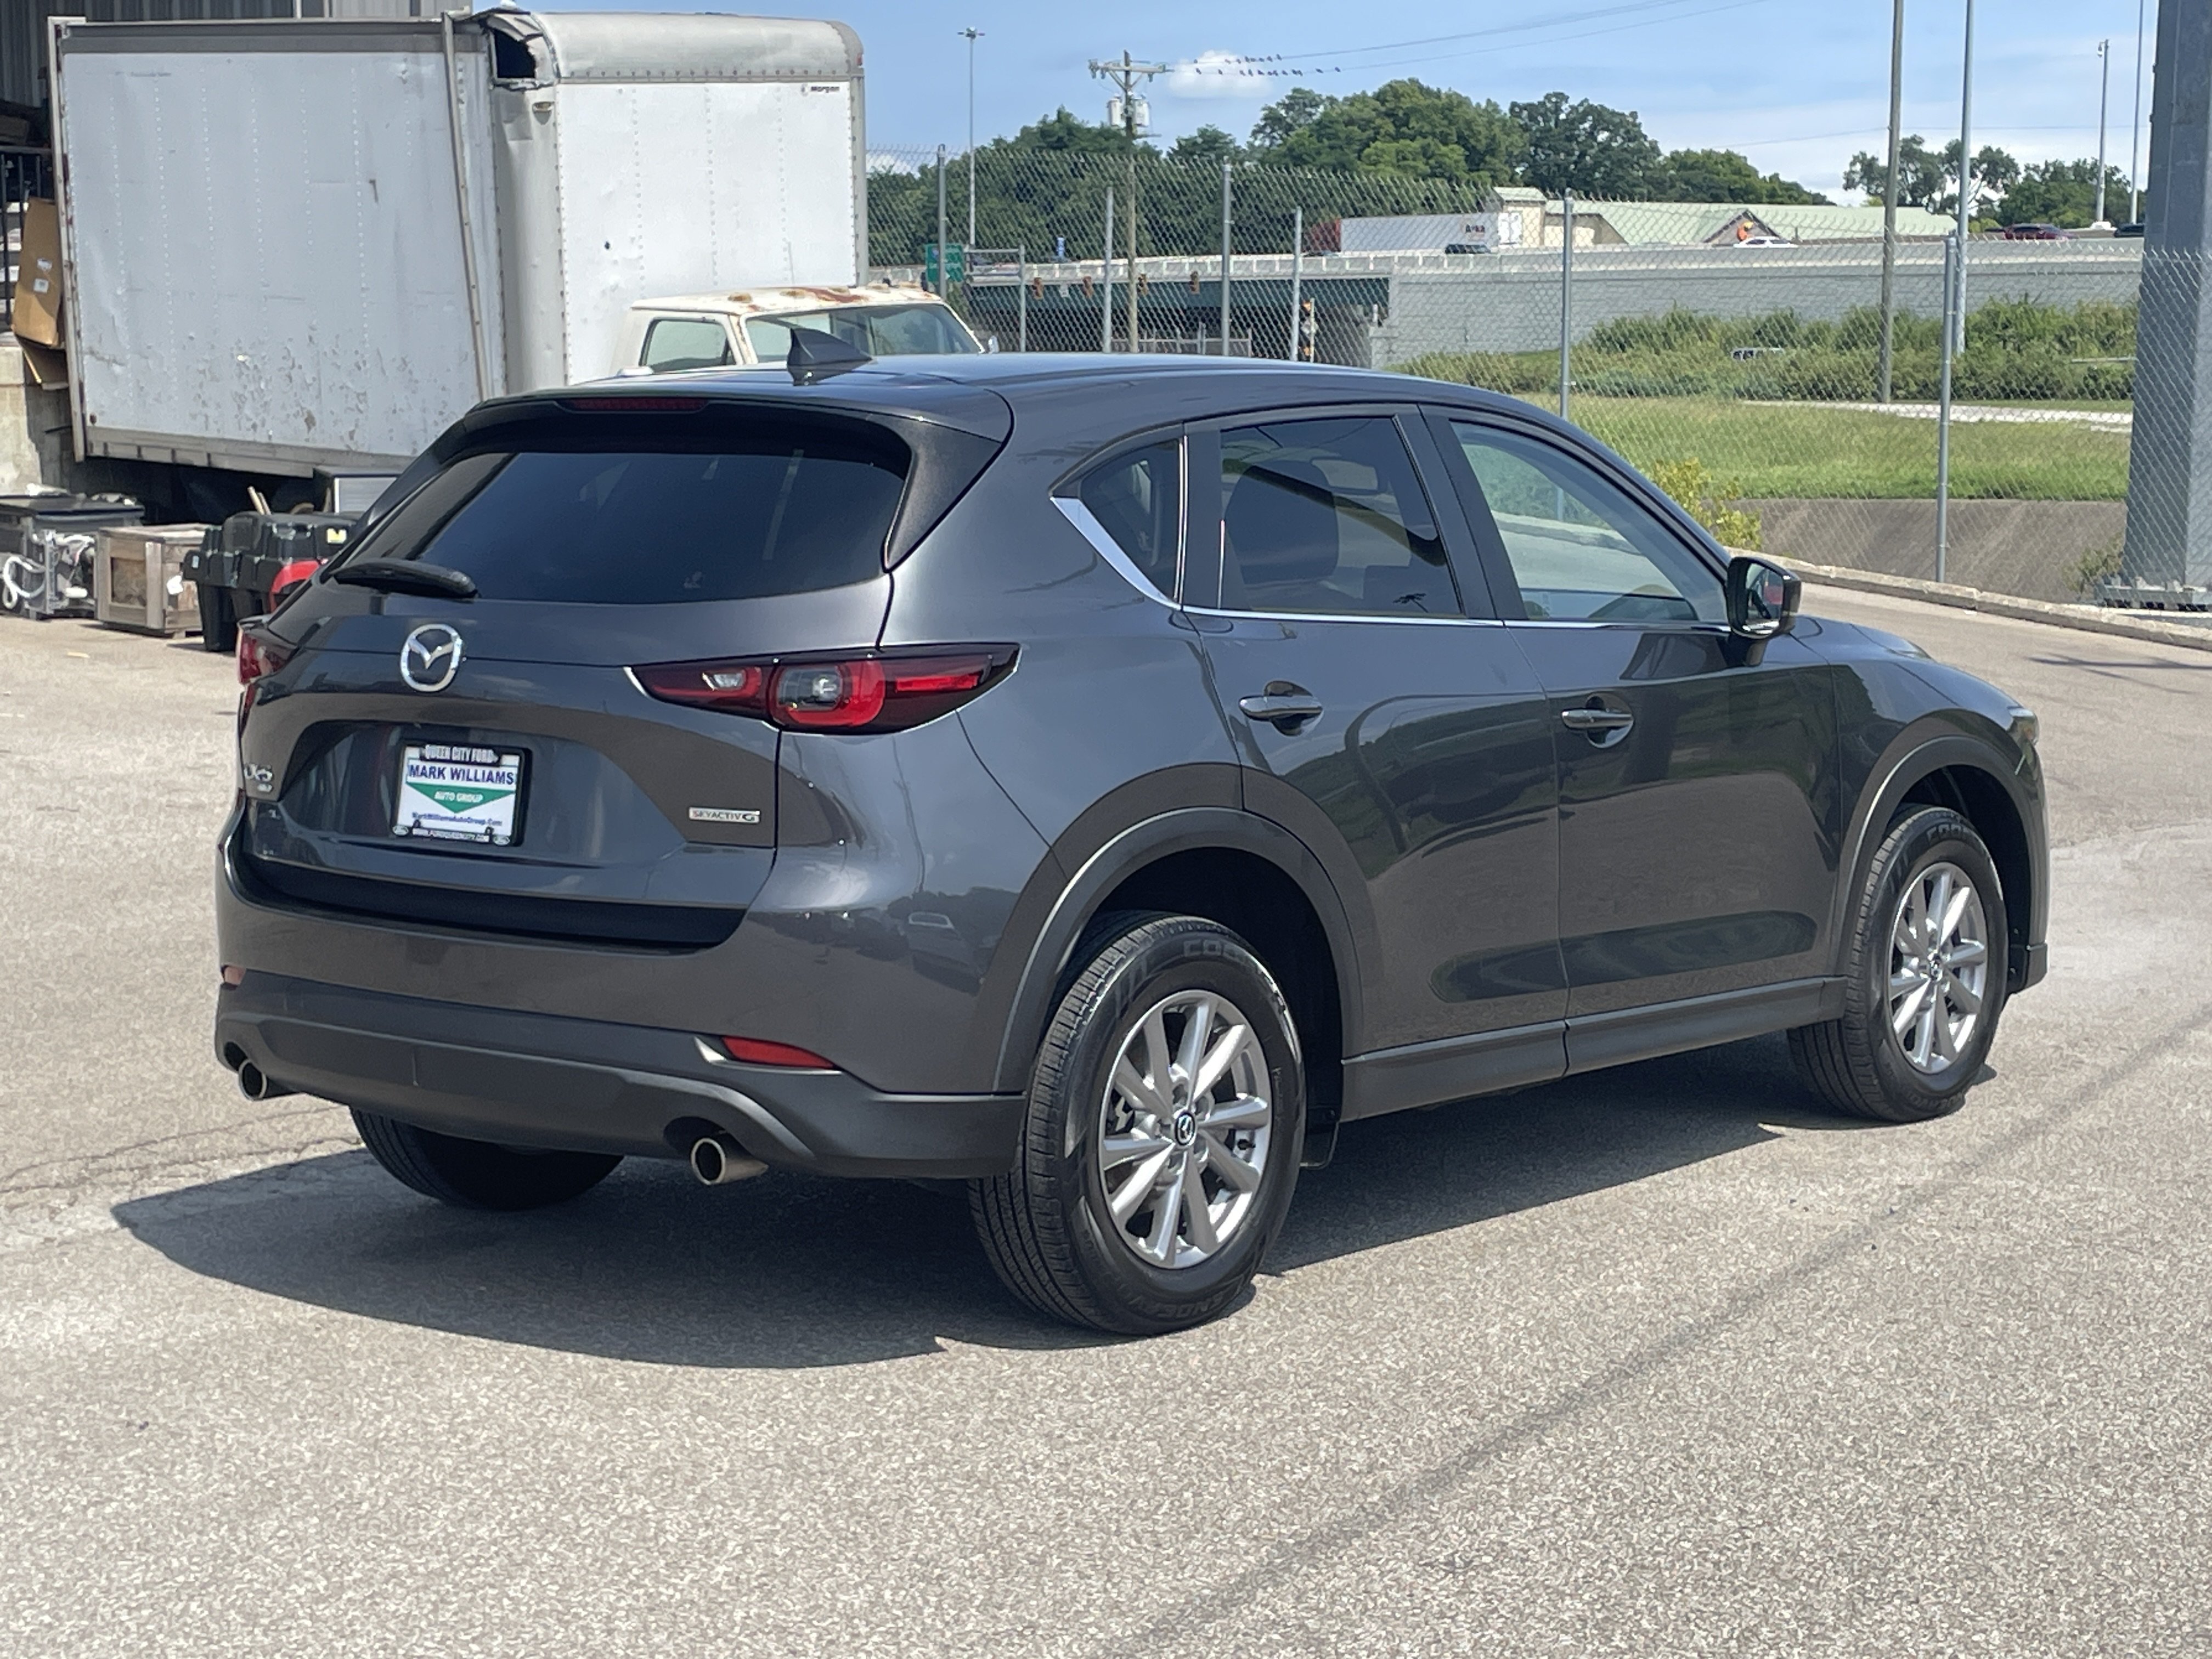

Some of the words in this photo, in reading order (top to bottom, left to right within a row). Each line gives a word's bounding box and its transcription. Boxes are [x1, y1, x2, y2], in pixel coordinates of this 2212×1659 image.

[425, 744, 451, 759] QUEEN
[452, 747, 471, 761] CITY
[409, 765, 445, 780] MARK
[450, 768, 514, 785] WILLIAMS
[434, 791, 455, 802] AUTO
